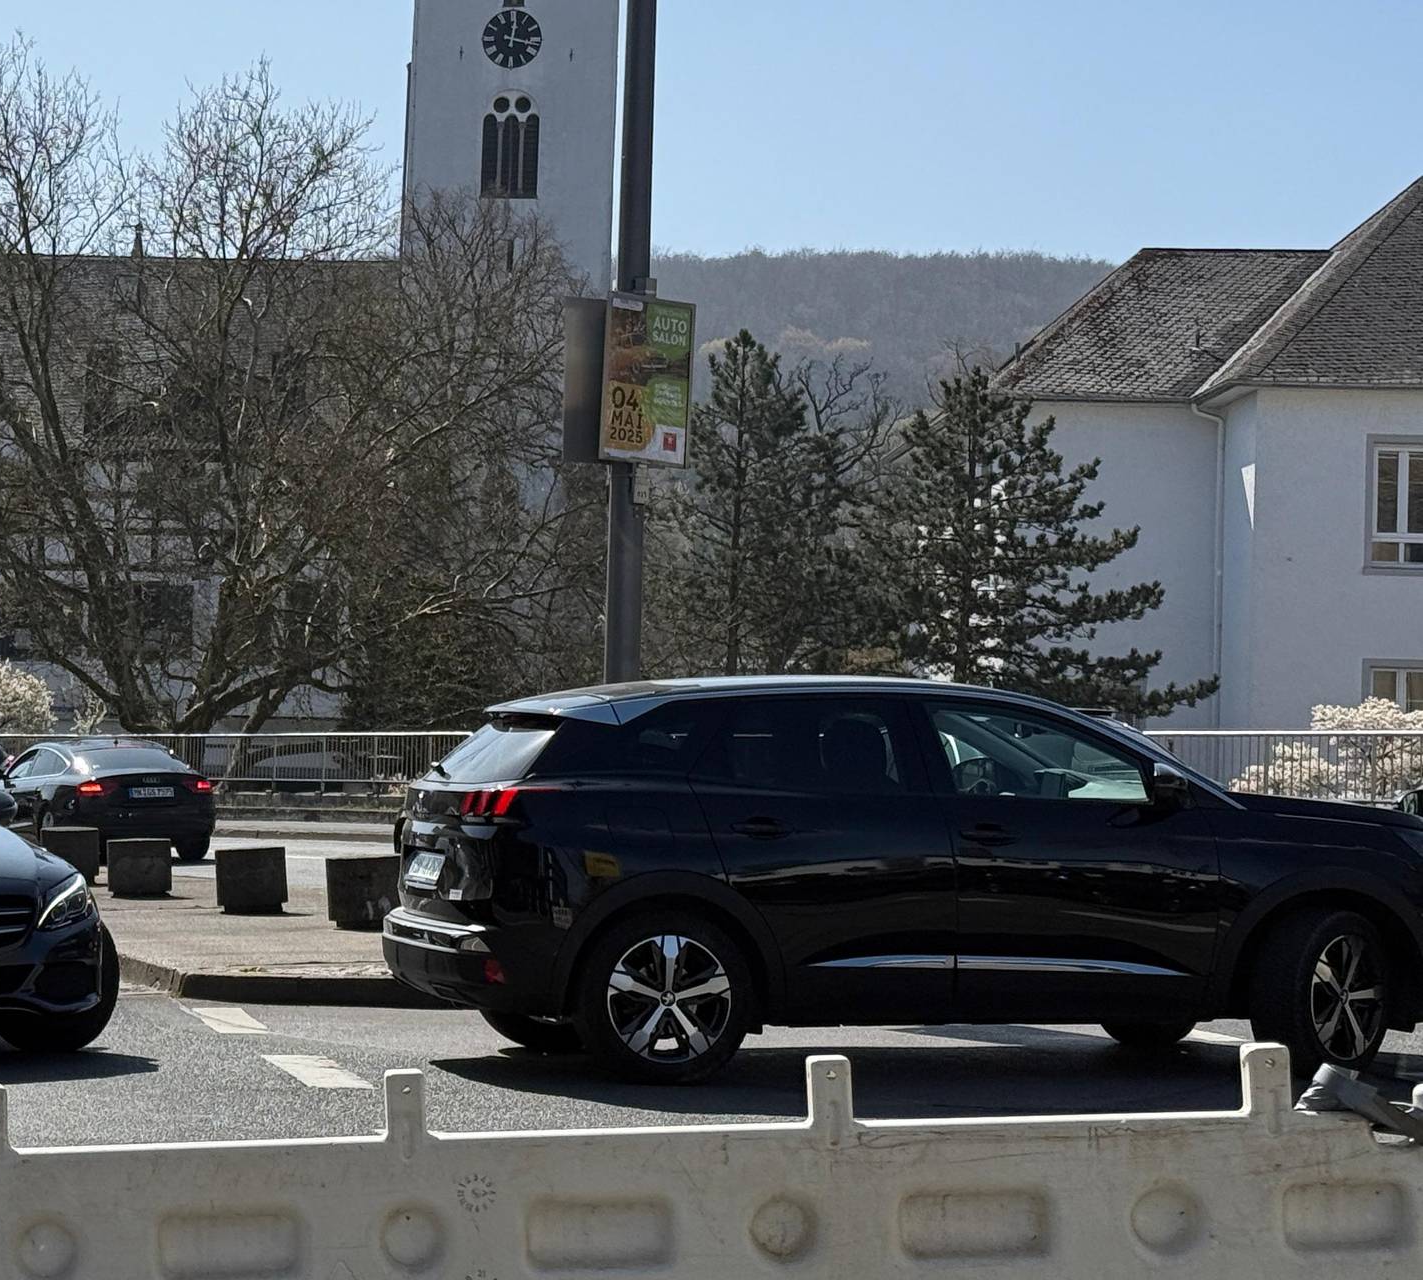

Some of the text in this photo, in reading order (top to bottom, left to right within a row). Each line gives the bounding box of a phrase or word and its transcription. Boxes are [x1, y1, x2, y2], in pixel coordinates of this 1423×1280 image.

[653, 316, 687, 334] AUTO
[652, 330, 687, 346] SALON
[611, 410, 644, 430] MAI
[610, 427, 643, 444] 2025
